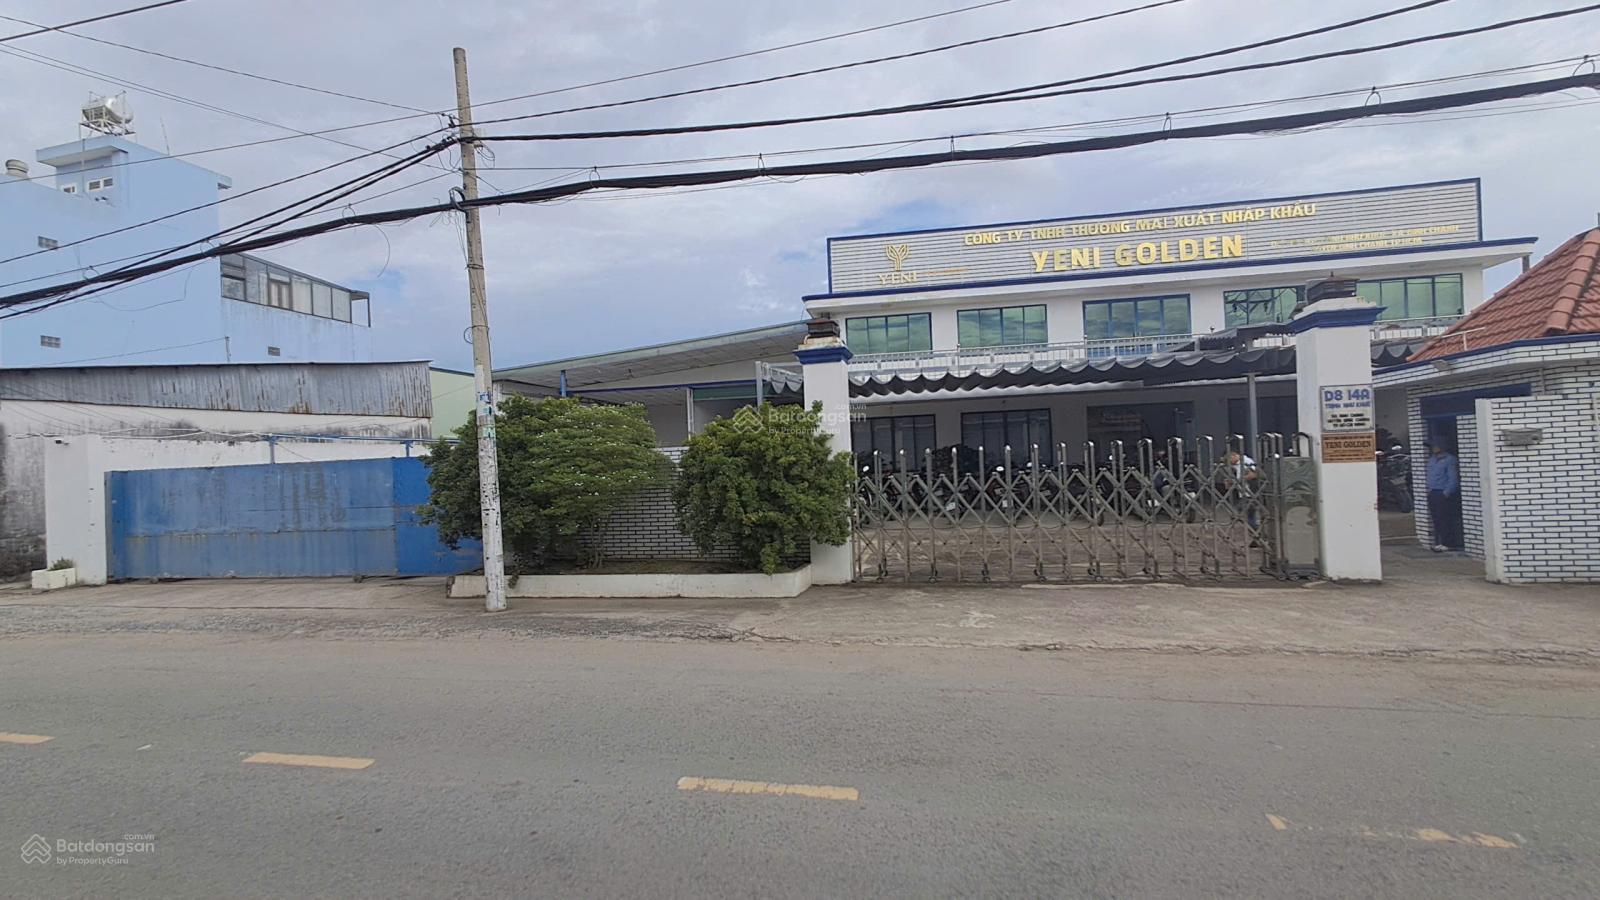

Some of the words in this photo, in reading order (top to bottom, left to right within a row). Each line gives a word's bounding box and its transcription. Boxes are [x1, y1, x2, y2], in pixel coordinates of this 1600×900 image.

[1031, 246, 1101, 273] YENI
[1114, 233, 1244, 267] GOLDEN
[878, 271, 918, 286] YENI
